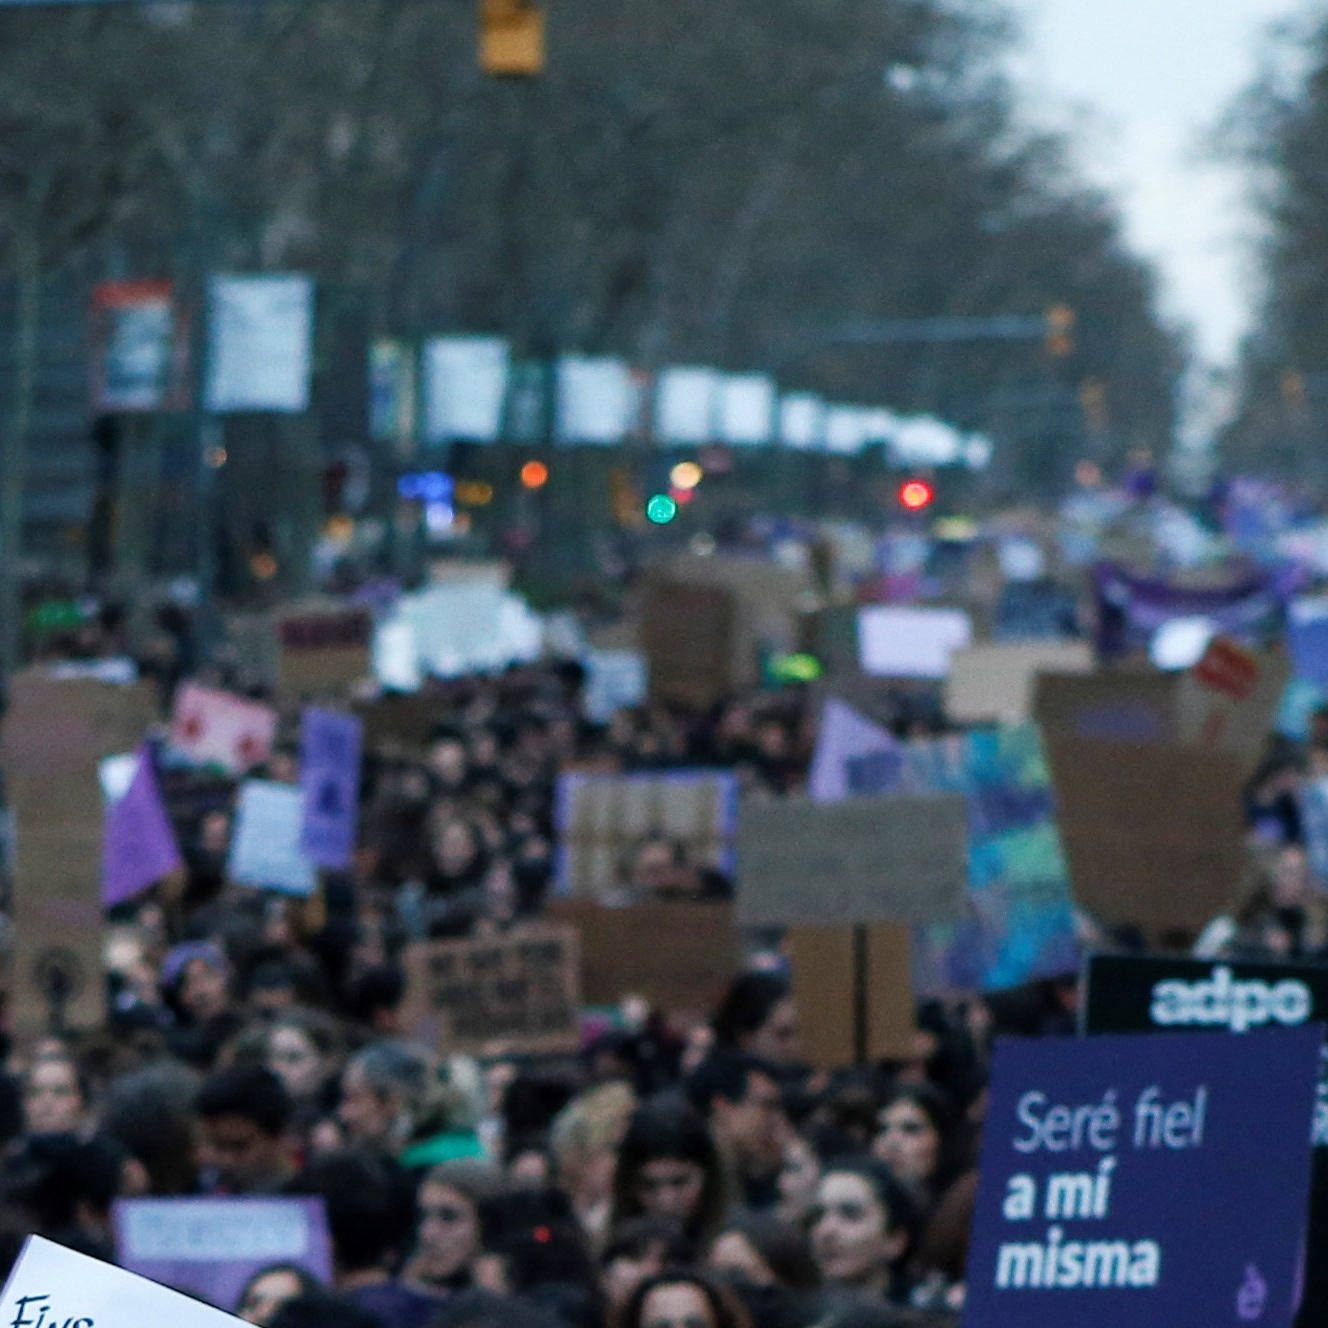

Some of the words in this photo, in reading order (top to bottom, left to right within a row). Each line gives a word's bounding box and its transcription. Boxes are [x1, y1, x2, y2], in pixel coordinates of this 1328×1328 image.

[1013, 1088, 1121, 1153] Seré
[1132, 1083, 1207, 1149] fiel
[1002, 1171, 1037, 1221] a
[1043, 1154, 1117, 1220] mí
[994, 1224, 1162, 1289] misma
